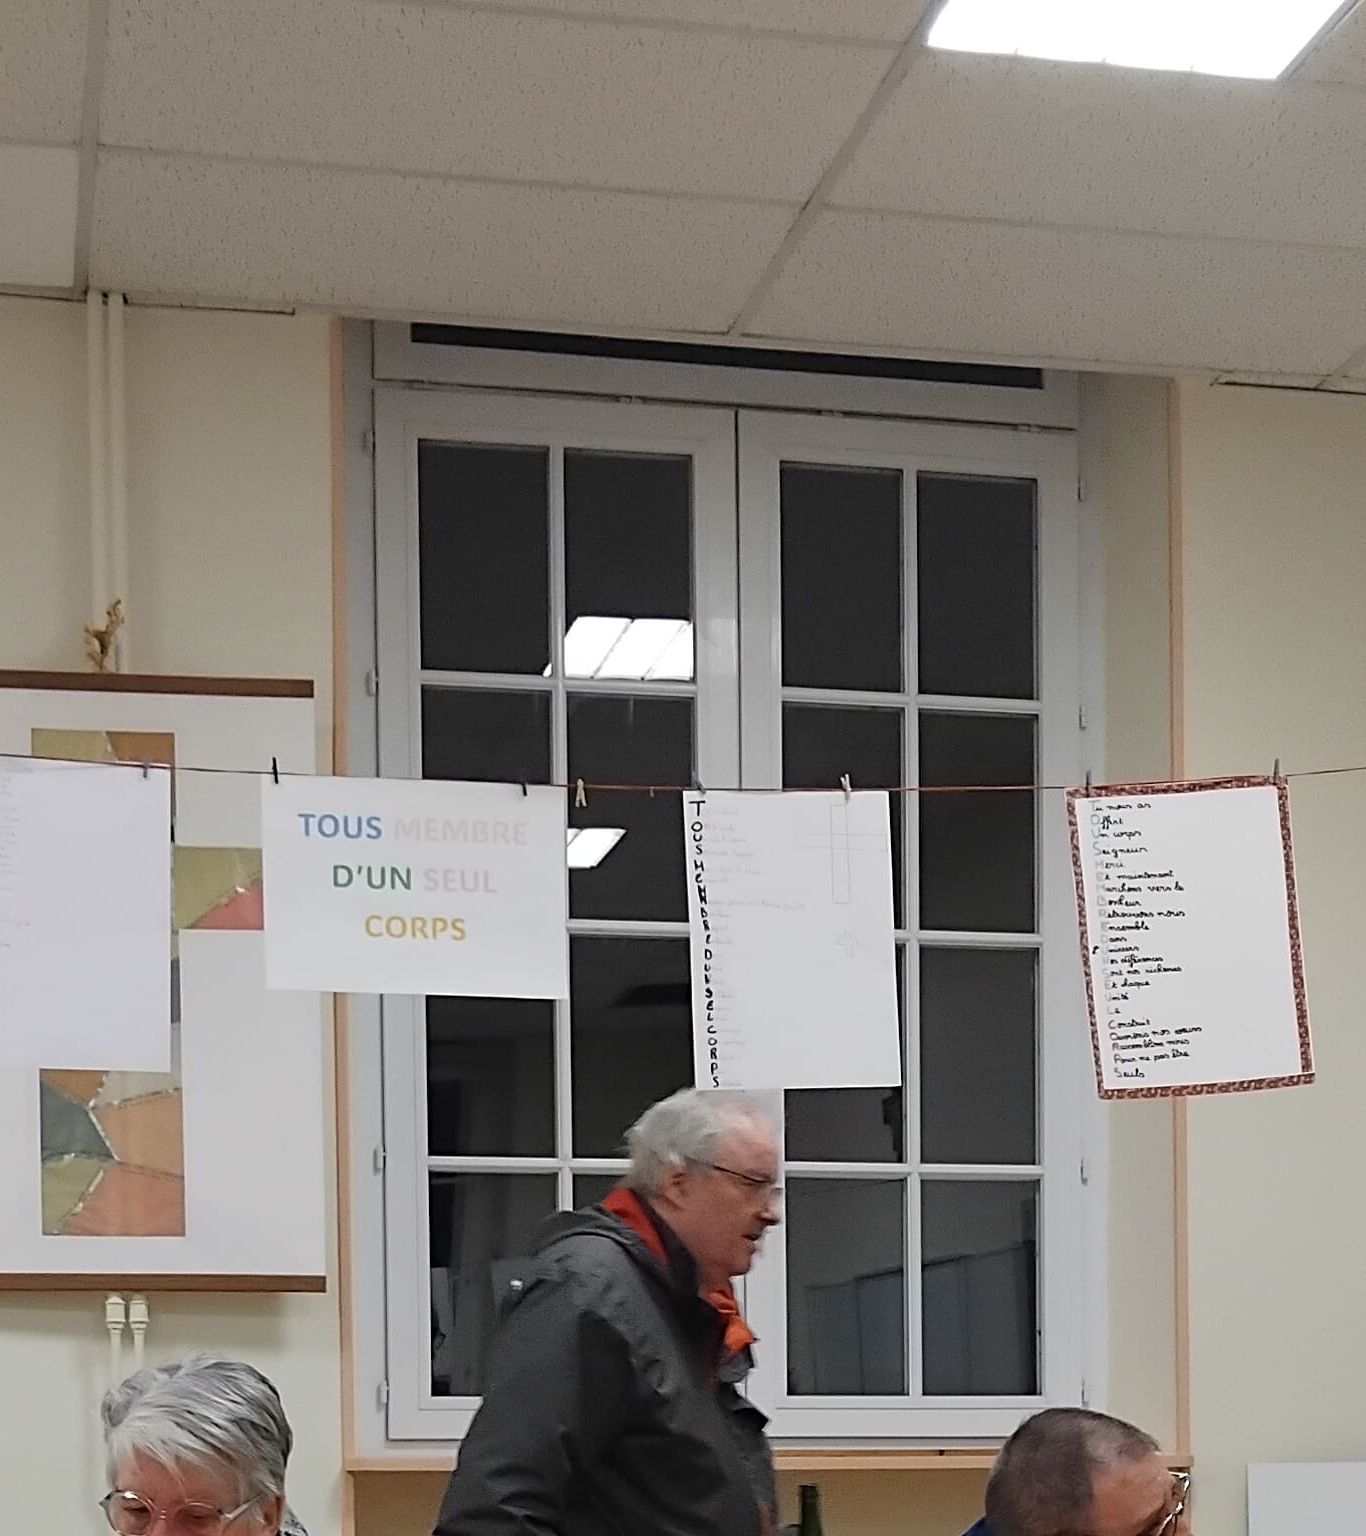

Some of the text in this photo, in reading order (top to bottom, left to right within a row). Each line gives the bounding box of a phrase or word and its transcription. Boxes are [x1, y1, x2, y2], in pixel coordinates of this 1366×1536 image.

[297, 812, 529, 846] TOUS MEMBRE
[1092, 841, 1148, 859] Seigneur
[1095, 861, 1124, 870] Merci
[1116, 869, 1174, 880] maintenant
[332, 864, 499, 894] D'UN SEUL
[364, 914, 467, 942] CORPS
[1101, 920, 1150, 932] Ensemble
[688, 800, 706, 855] TOUS
[707, 1025, 719, 1088] CORPS
[1114, 1067, 1146, 1078] Seuls
